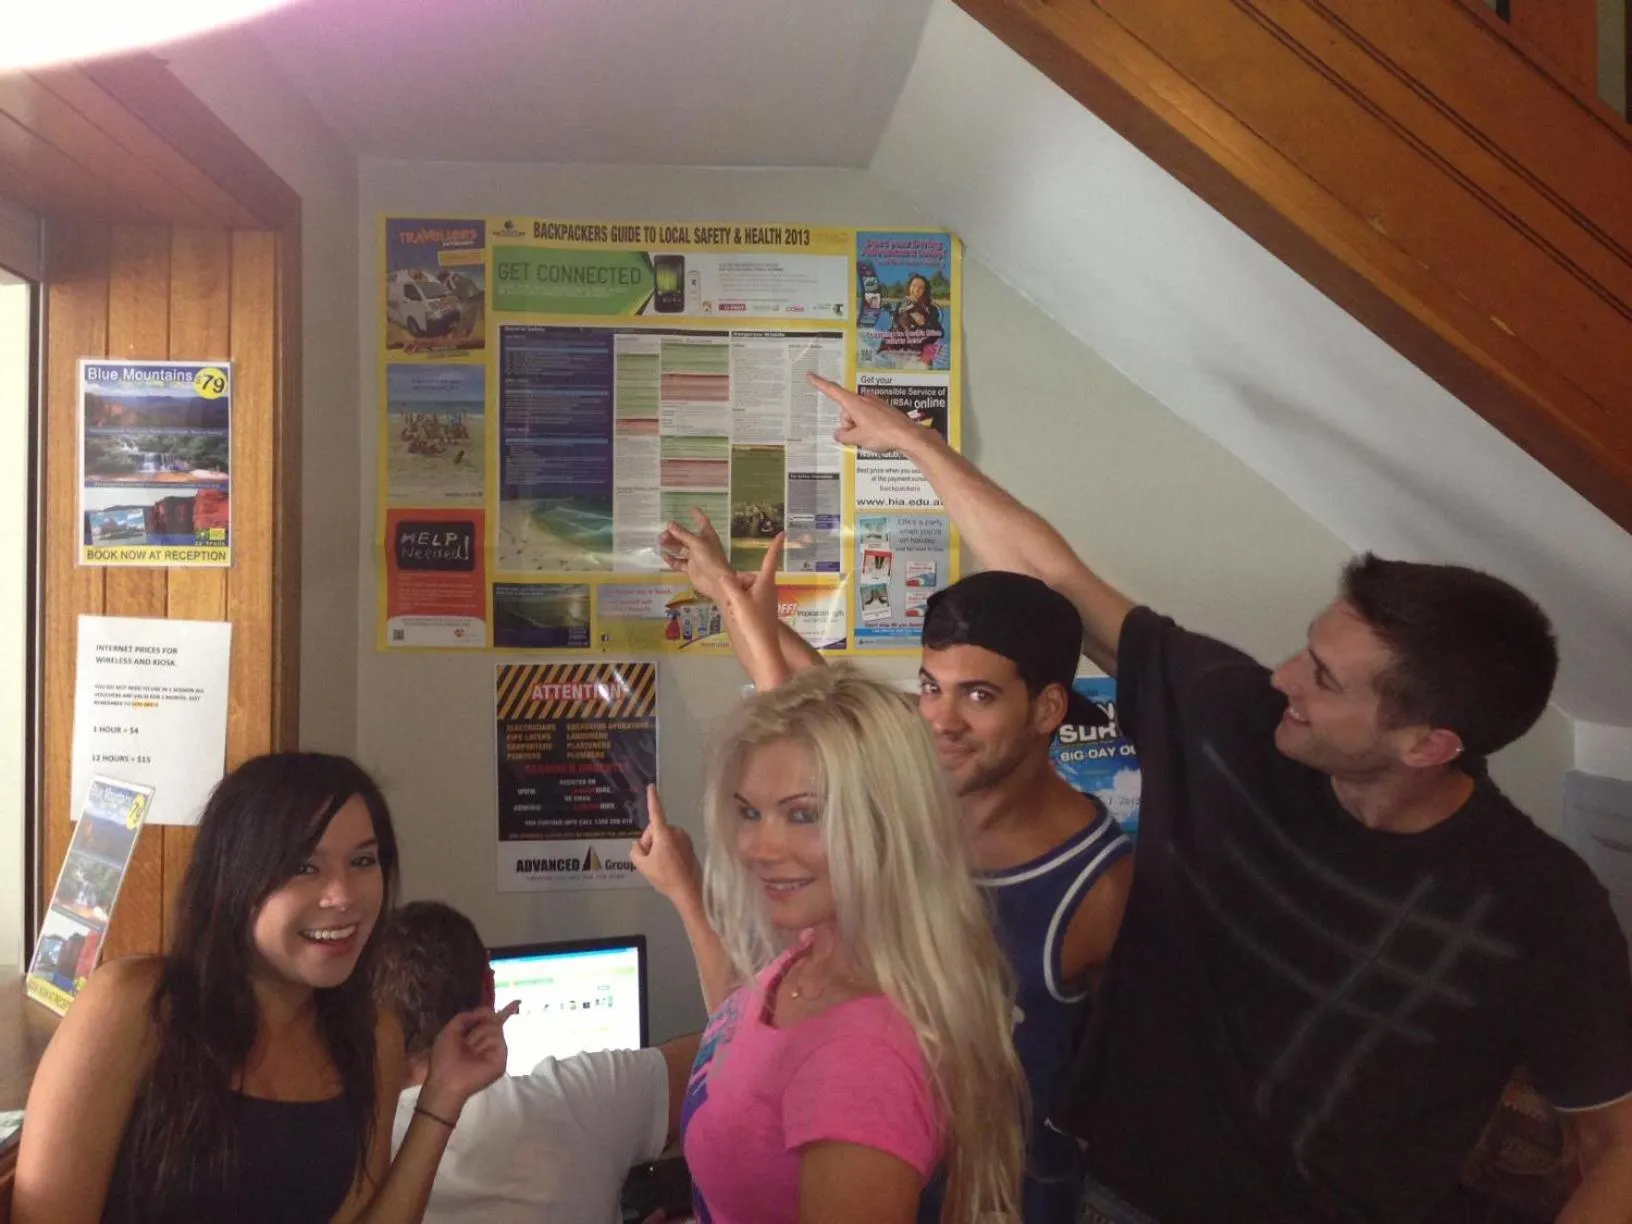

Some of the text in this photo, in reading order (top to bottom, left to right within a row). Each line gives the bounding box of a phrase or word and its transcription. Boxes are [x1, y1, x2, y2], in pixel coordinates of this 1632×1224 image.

[533, 221, 608, 243] BACKPACKERS
[611, 225, 641, 243] GUIDE
[644, 226, 656, 243] TO
[660, 226, 690, 244] LOCAL
[694, 227, 731, 245] SAFETY
[733, 228, 742, 244] &
[745, 228, 781, 245] HEALTH
[785, 228, 810, 246] 2013
[497, 262, 642, 286] GET CONNECTED
[88, 366, 118, 380] Blue
[123, 367, 193, 381] Mountains
[860, 375, 893, 386] Get your
[907, 387, 937, 396] Service
[938, 387, 946, 396] of
[914, 396, 946, 409] online
[87, 549, 226, 561] BOOK NOW AT RECEPTION
[96, 644, 178, 655] INTERNET PRICES FOR
[95, 656, 132, 665] WIRELESS
[134, 658, 151, 666] AND
[100, 726, 122, 734] HOUR
[129, 726, 139, 735] $4
[92, 754, 101, 762] 12
[102, 755, 129, 763] HOURS
[137, 756, 151, 764] $15
[1060, 750, 1085, 762] BIG
[1088, 747, 1116, 759] DAY
[516, 857, 637, 874] ADVANCED Group
